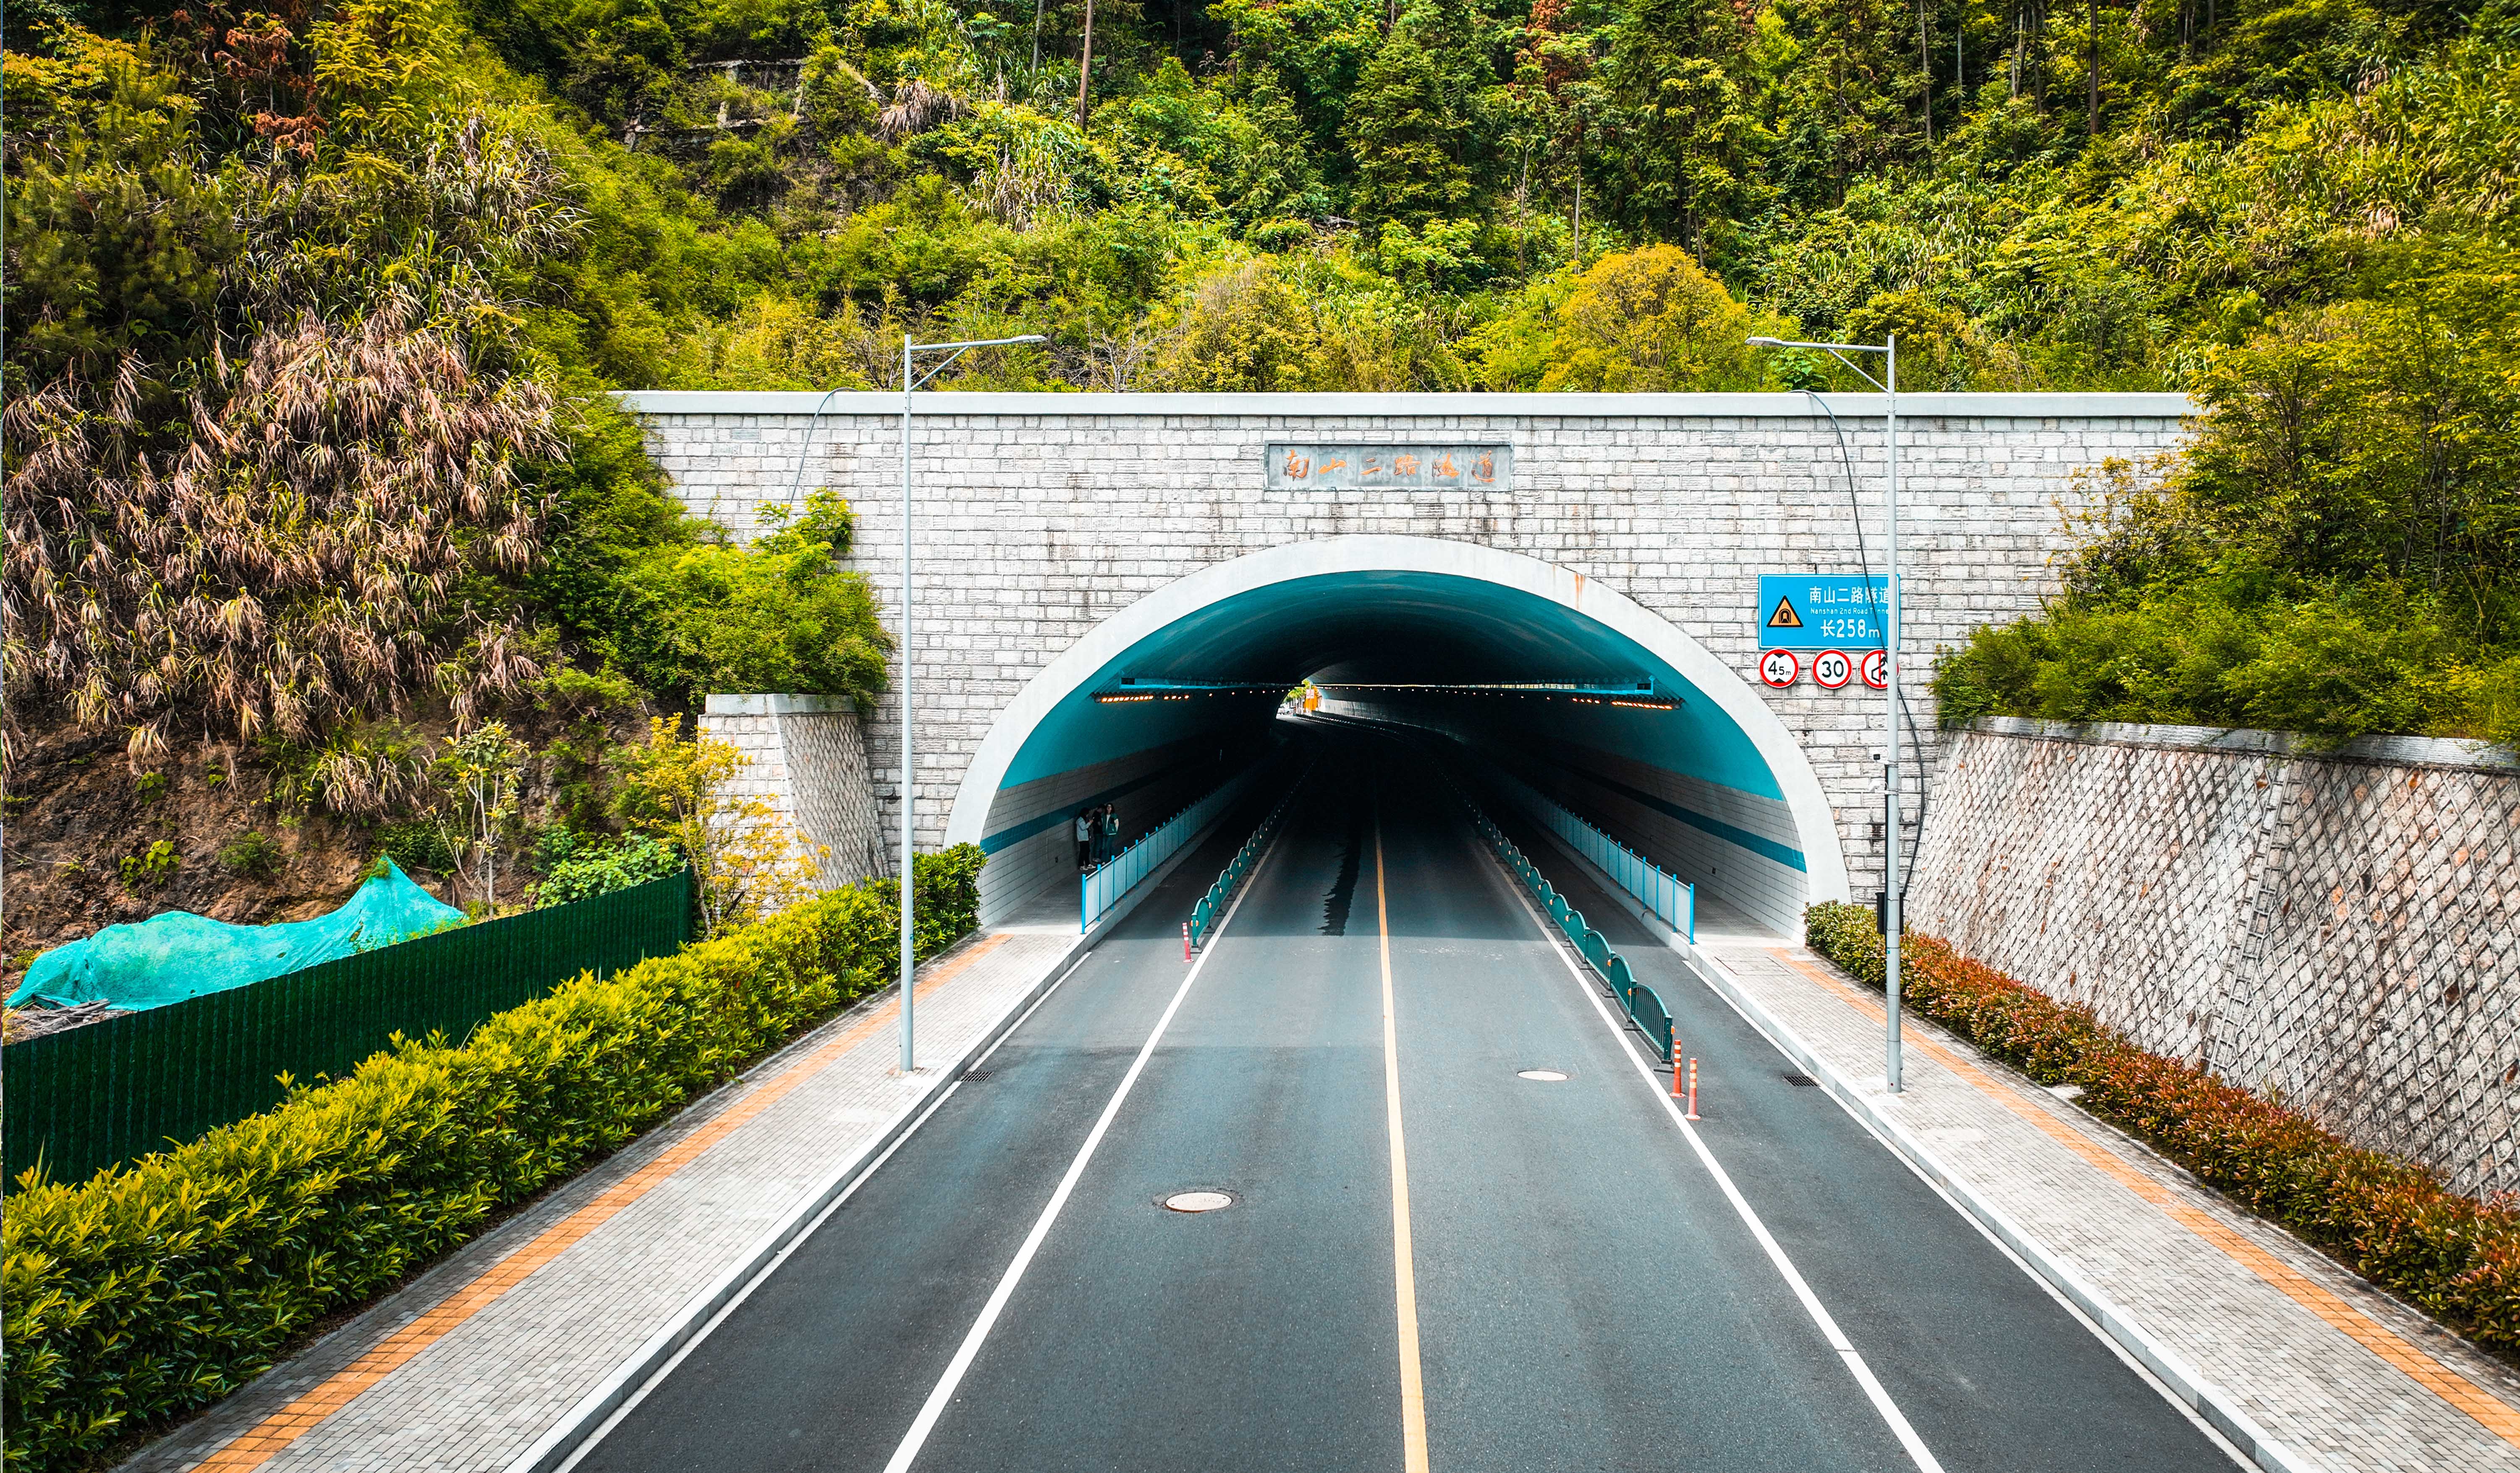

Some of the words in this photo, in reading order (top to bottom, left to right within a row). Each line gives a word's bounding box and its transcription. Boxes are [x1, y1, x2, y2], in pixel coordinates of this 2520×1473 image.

[1809, 586, 1888, 604] 南山二路隧道
[1821, 660, 1844, 678] 30
